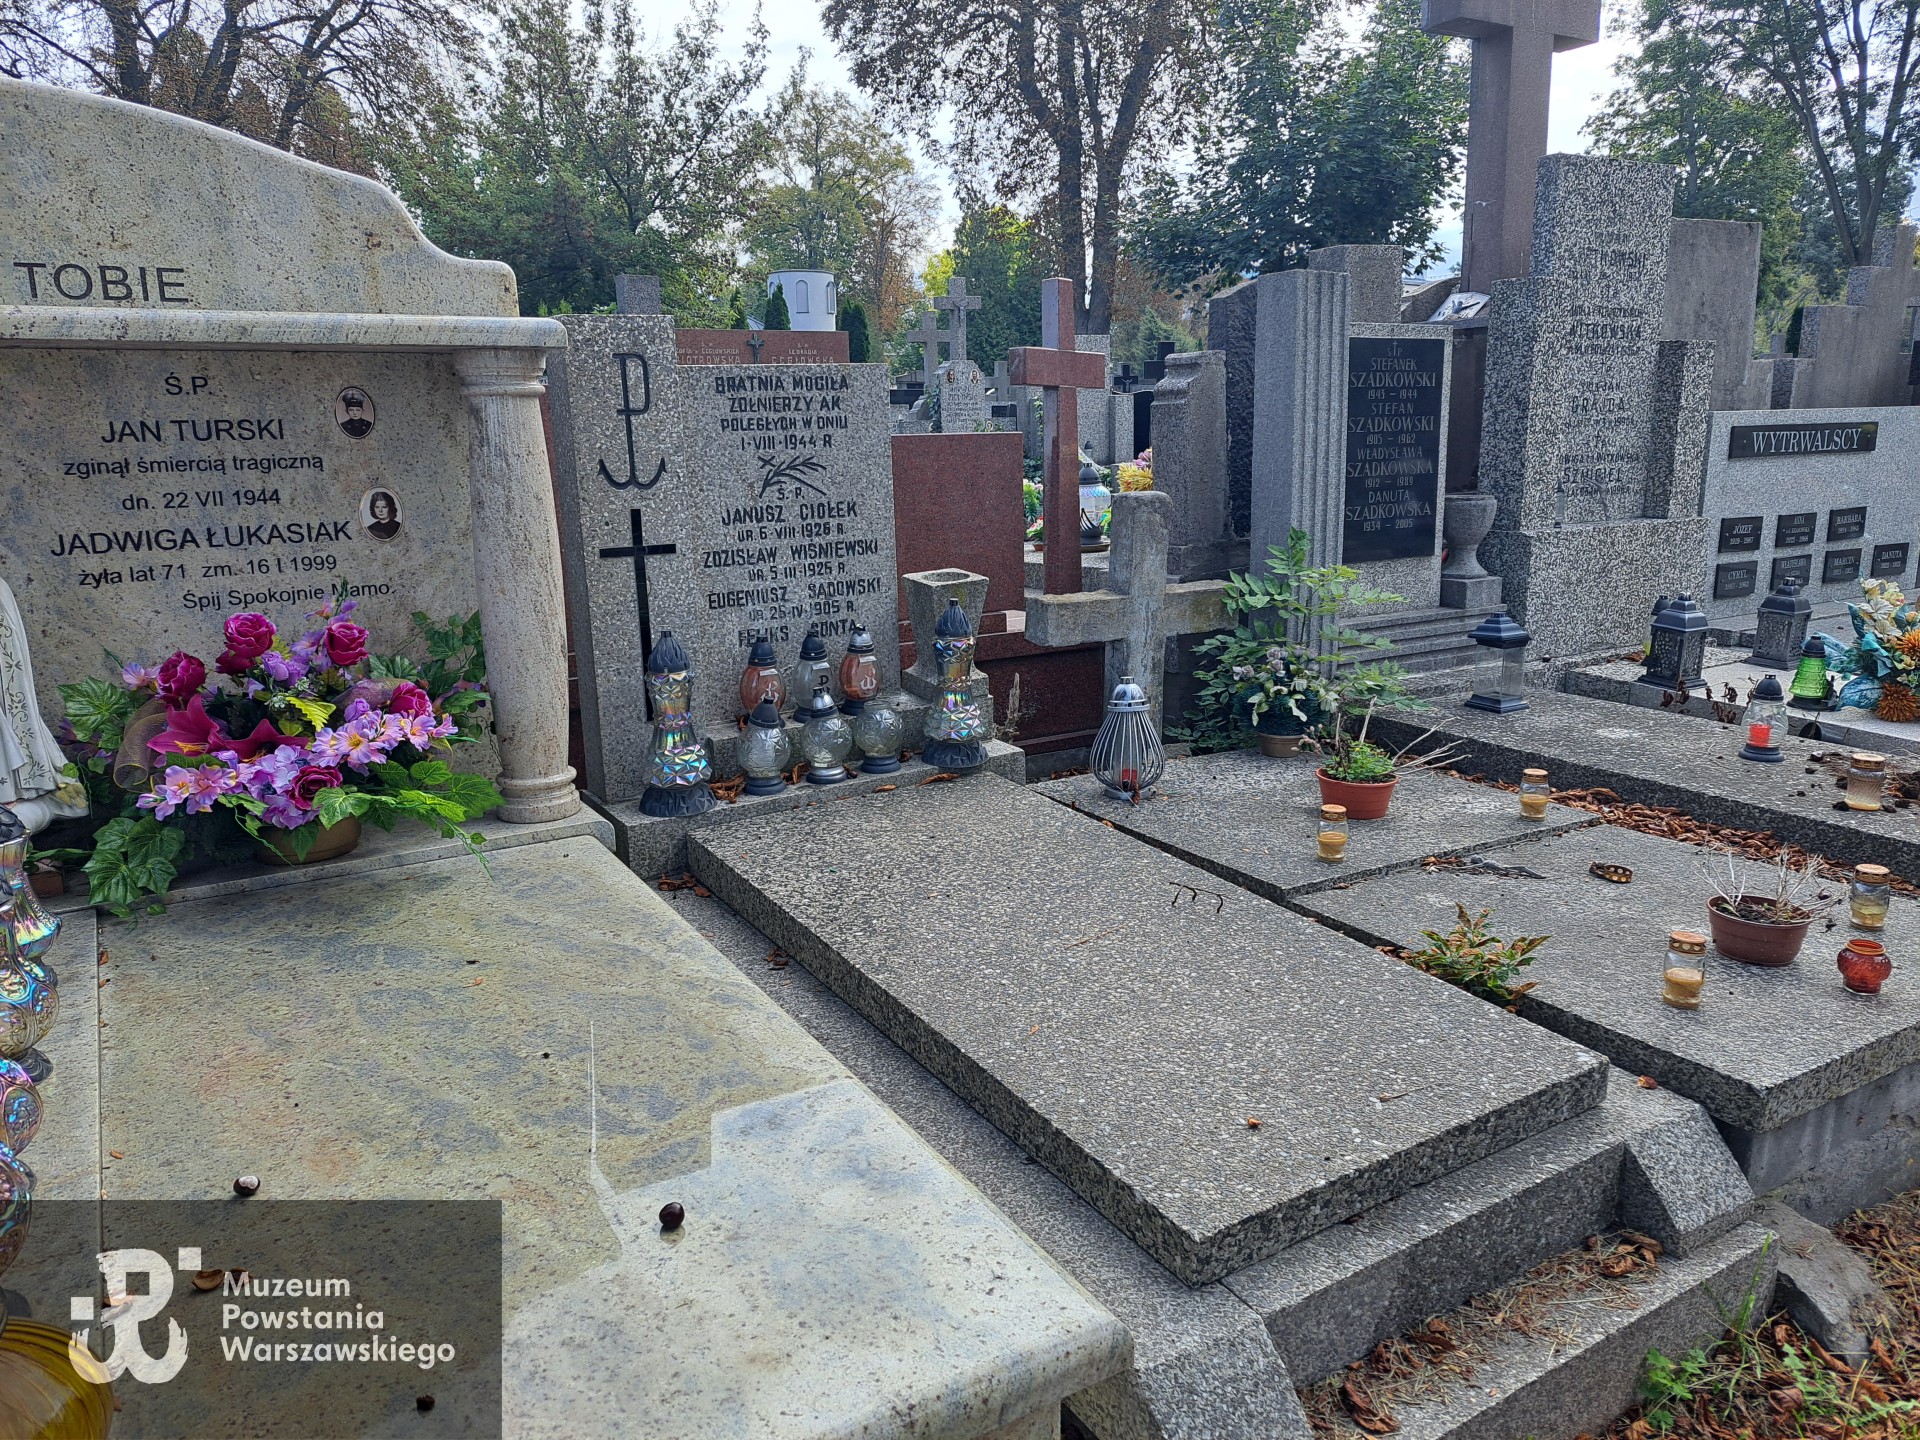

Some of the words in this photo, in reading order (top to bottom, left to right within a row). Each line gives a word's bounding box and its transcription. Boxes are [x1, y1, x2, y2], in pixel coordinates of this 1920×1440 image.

[13, 262, 189, 302] TOBIE
[1370, 357, 1417, 371] STEFANEK
[715, 375, 784, 394] BRATNIA
[793, 374, 849, 391] MOGIŁA
[1350, 371, 1436, 387] SZADKOWSKI
[727, 393, 813, 413] ŻOŁNIERZY
[820, 395, 841, 411] AK
[1400, 389, 1417, 399] 1944
[1371, 402, 1414, 415] STEFAN
[101, 420, 163, 443] JAN
[170, 418, 285, 442] TURSKI
[802, 416, 812, 429] W
[817, 415, 848, 430] DNIU
[1348, 415, 1434, 433] SZADKOWSKI
[1752, 428, 1863, 454] WYTRWALSCY
[1357, 446, 1423, 460] WŁADYSŁAWA
[63, 457, 130, 479] zginął
[137, 455, 227, 475] śmiercią
[232, 455, 324, 475] tragiczną
[1347, 459, 1434, 478] SZADKOWSKA
[122, 493, 155, 511] dn.
[163, 492, 189, 509] 22
[196, 490, 224, 508] VII
[232, 489, 281, 506] 1944
[1368, 489, 1410, 503] DANUTA
[721, 505, 786, 526] JANUSZ
[800, 501, 858, 521] CIOŁEK
[1345, 501, 1432, 521] SZADKOWSKA
[737, 529, 757, 543] UR.
[1733, 523, 1754, 534] JÓZEF
[51, 528, 200, 557] JADWIGA
[206, 521, 353, 547] ŁUKASIAK
[703, 547, 778, 568] ZDZISŁAW
[790, 538, 878, 561] WIŚNIEWSKI
[78, 569, 123, 589] żyła
[129, 566, 155, 583] lat
[163, 564, 186, 581] 71
[202, 563, 237, 578] zm.
[246, 558, 270, 575] 16
[290, 555, 337, 572] 1999
[183, 590, 222, 611] Śpij
[228, 584, 325, 608] Spokojnie
[707, 586, 789, 610] EUGENIUSZ
[808, 577, 881, 599] SADOWSKI
